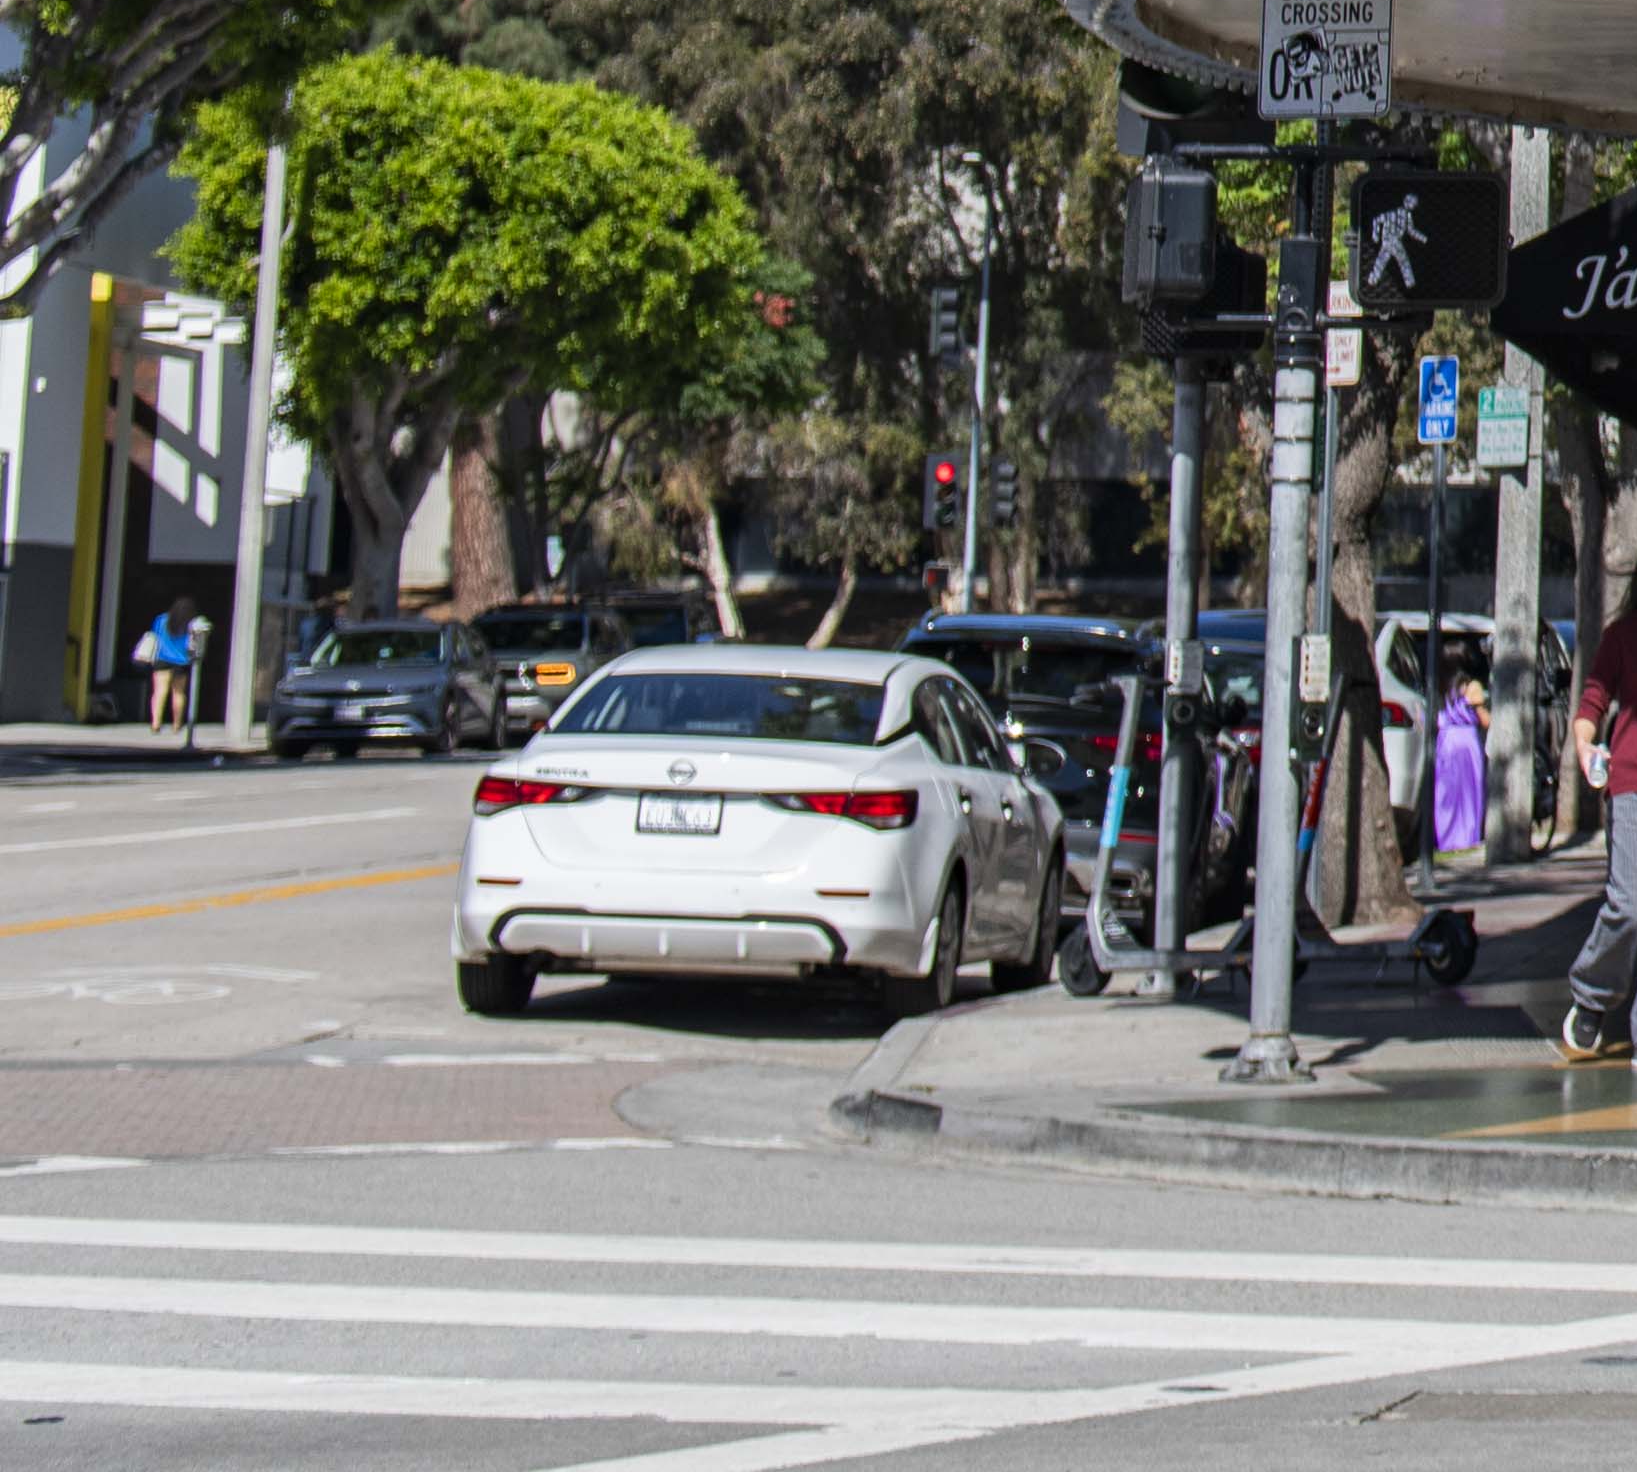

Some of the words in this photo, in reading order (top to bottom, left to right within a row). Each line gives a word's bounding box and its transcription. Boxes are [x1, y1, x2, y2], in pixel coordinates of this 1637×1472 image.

[1281, 1, 1373, 24] CROSSING
[1482, 390, 1494, 413] 2
[1426, 419, 1450, 438] ONLY
